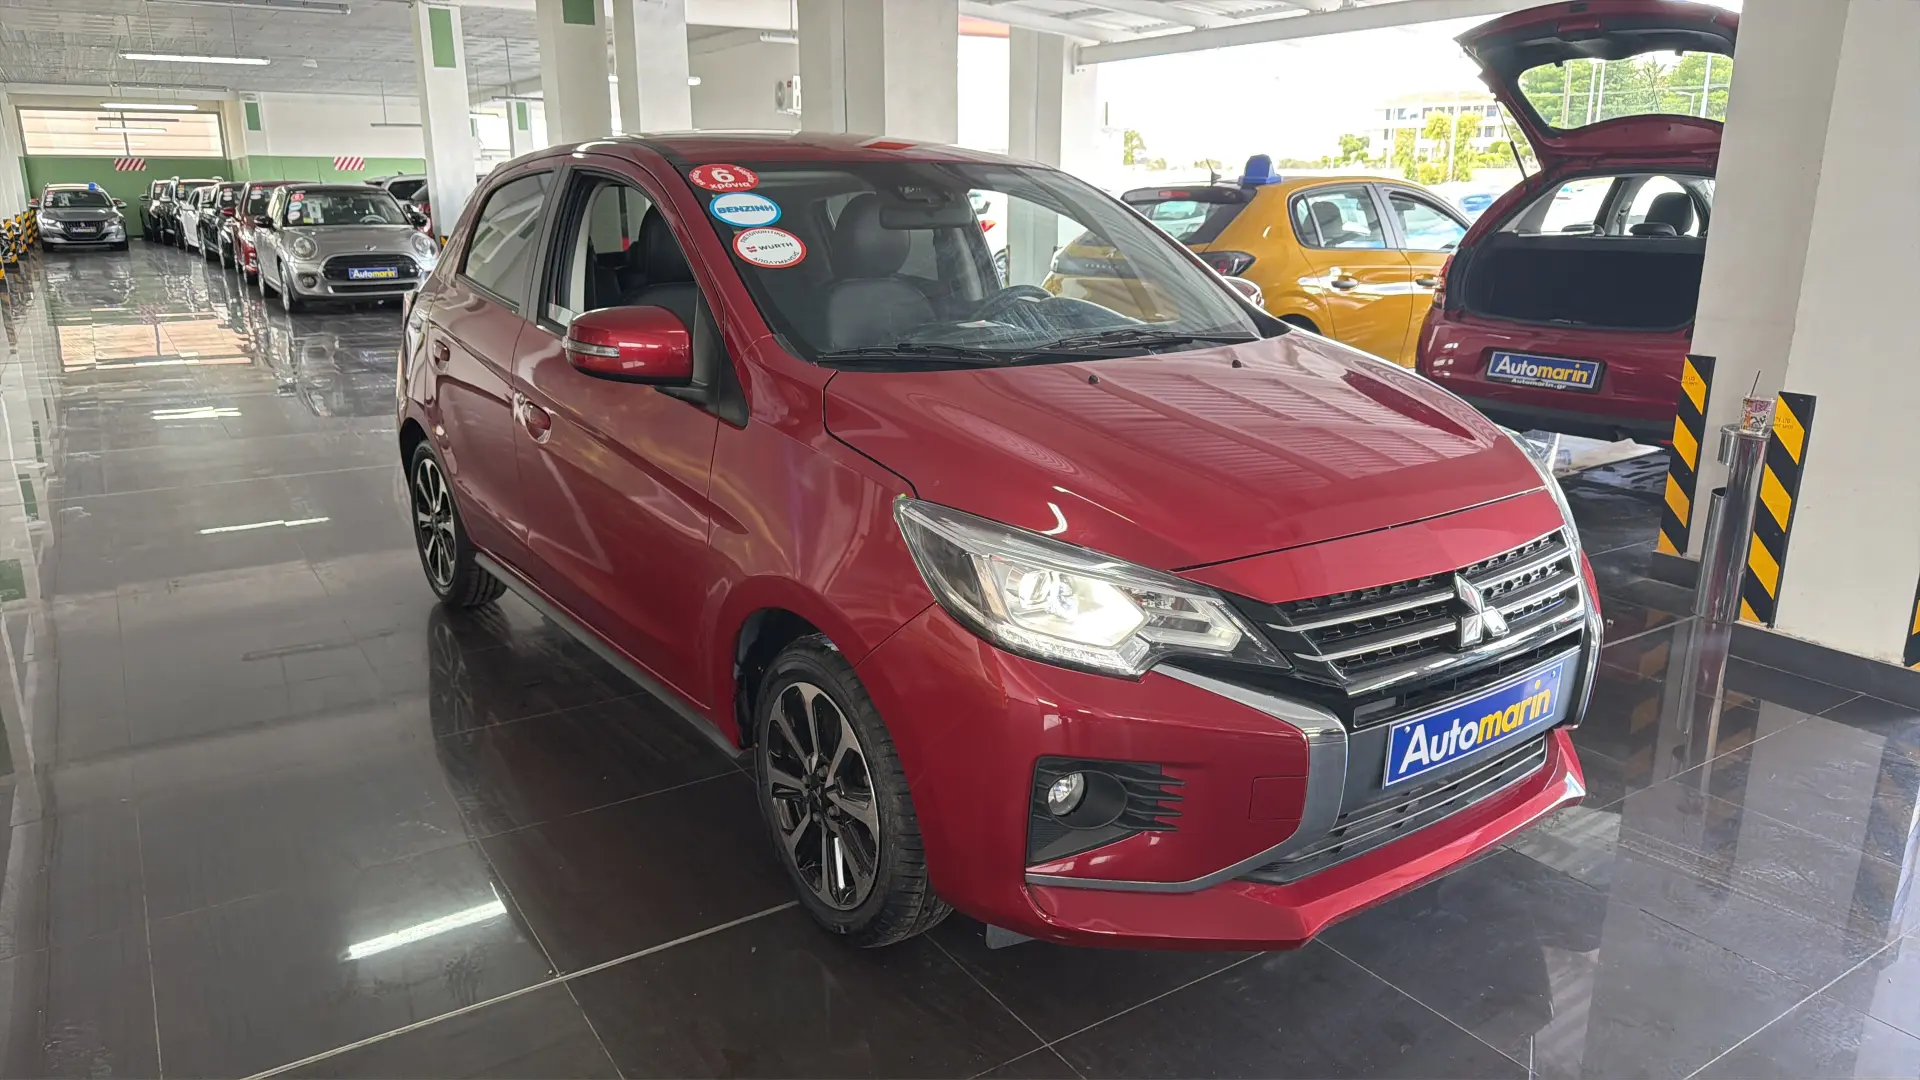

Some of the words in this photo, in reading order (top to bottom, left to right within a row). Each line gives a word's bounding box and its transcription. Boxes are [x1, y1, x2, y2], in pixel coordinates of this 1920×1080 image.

[711, 169, 735, 183] 6
[353, 268, 395, 279] Automarin
[1495, 355, 1588, 384] Automarin
[1511, 378, 1567, 390] Automarin.gr
[1398, 679, 1551, 775] Automarin
